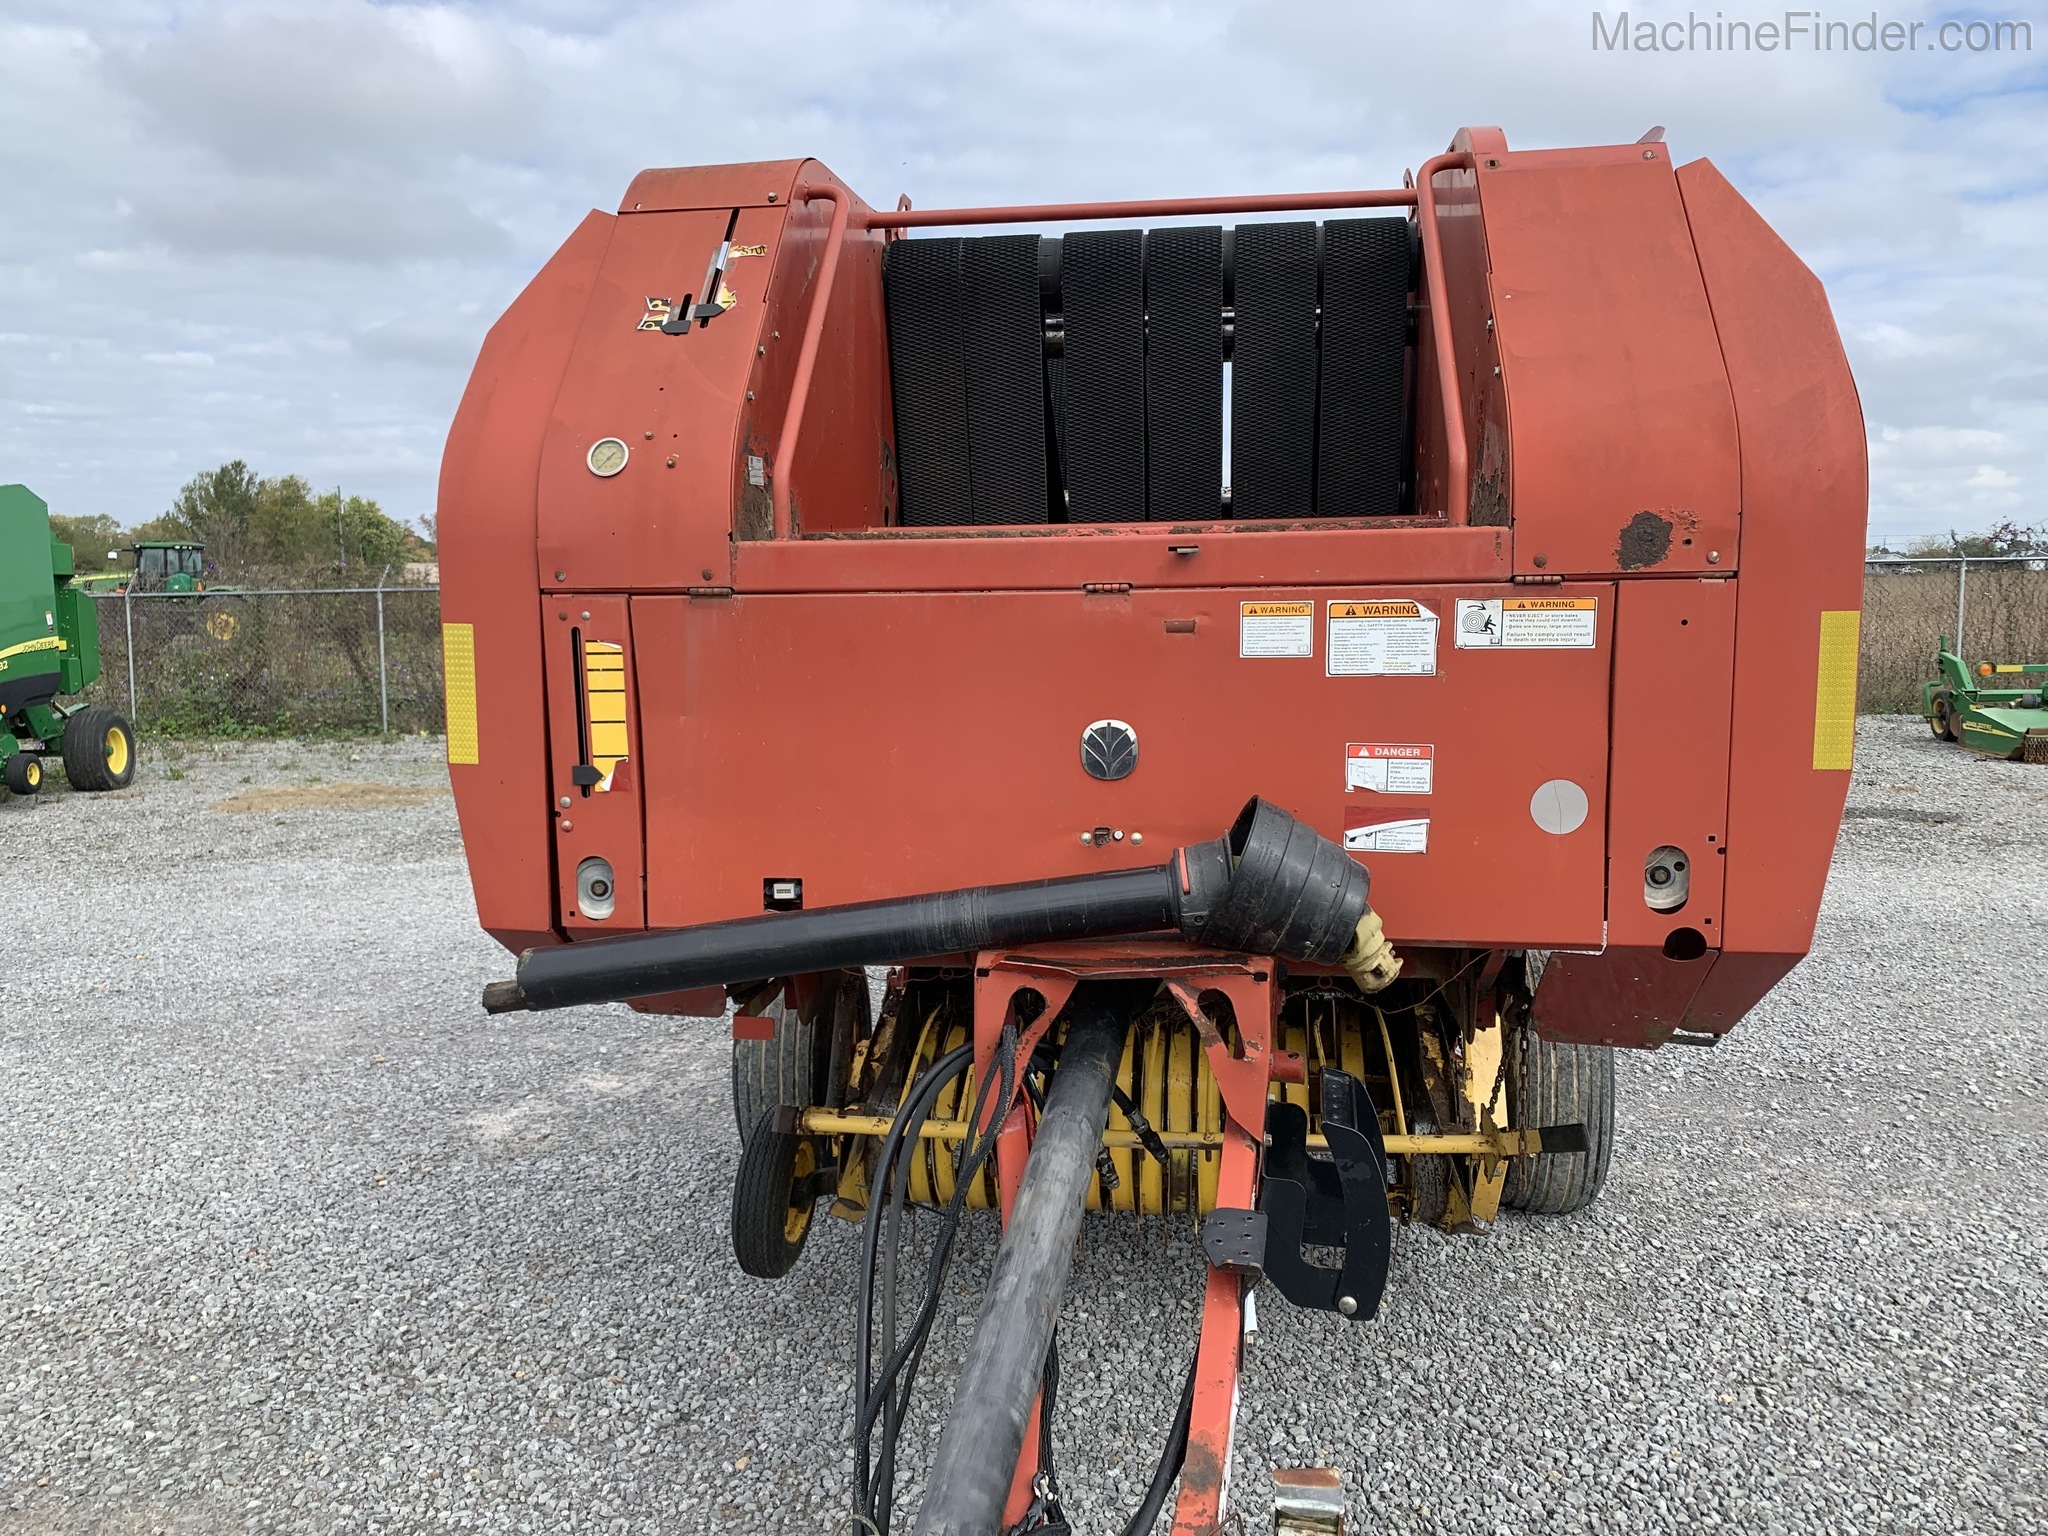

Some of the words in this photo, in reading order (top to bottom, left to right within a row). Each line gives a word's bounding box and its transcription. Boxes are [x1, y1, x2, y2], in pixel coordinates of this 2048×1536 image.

[1363, 605, 1420, 614] WARNING
[22, 644, 36, 652] JOHN
[36, 640, 54, 649] DEERE
